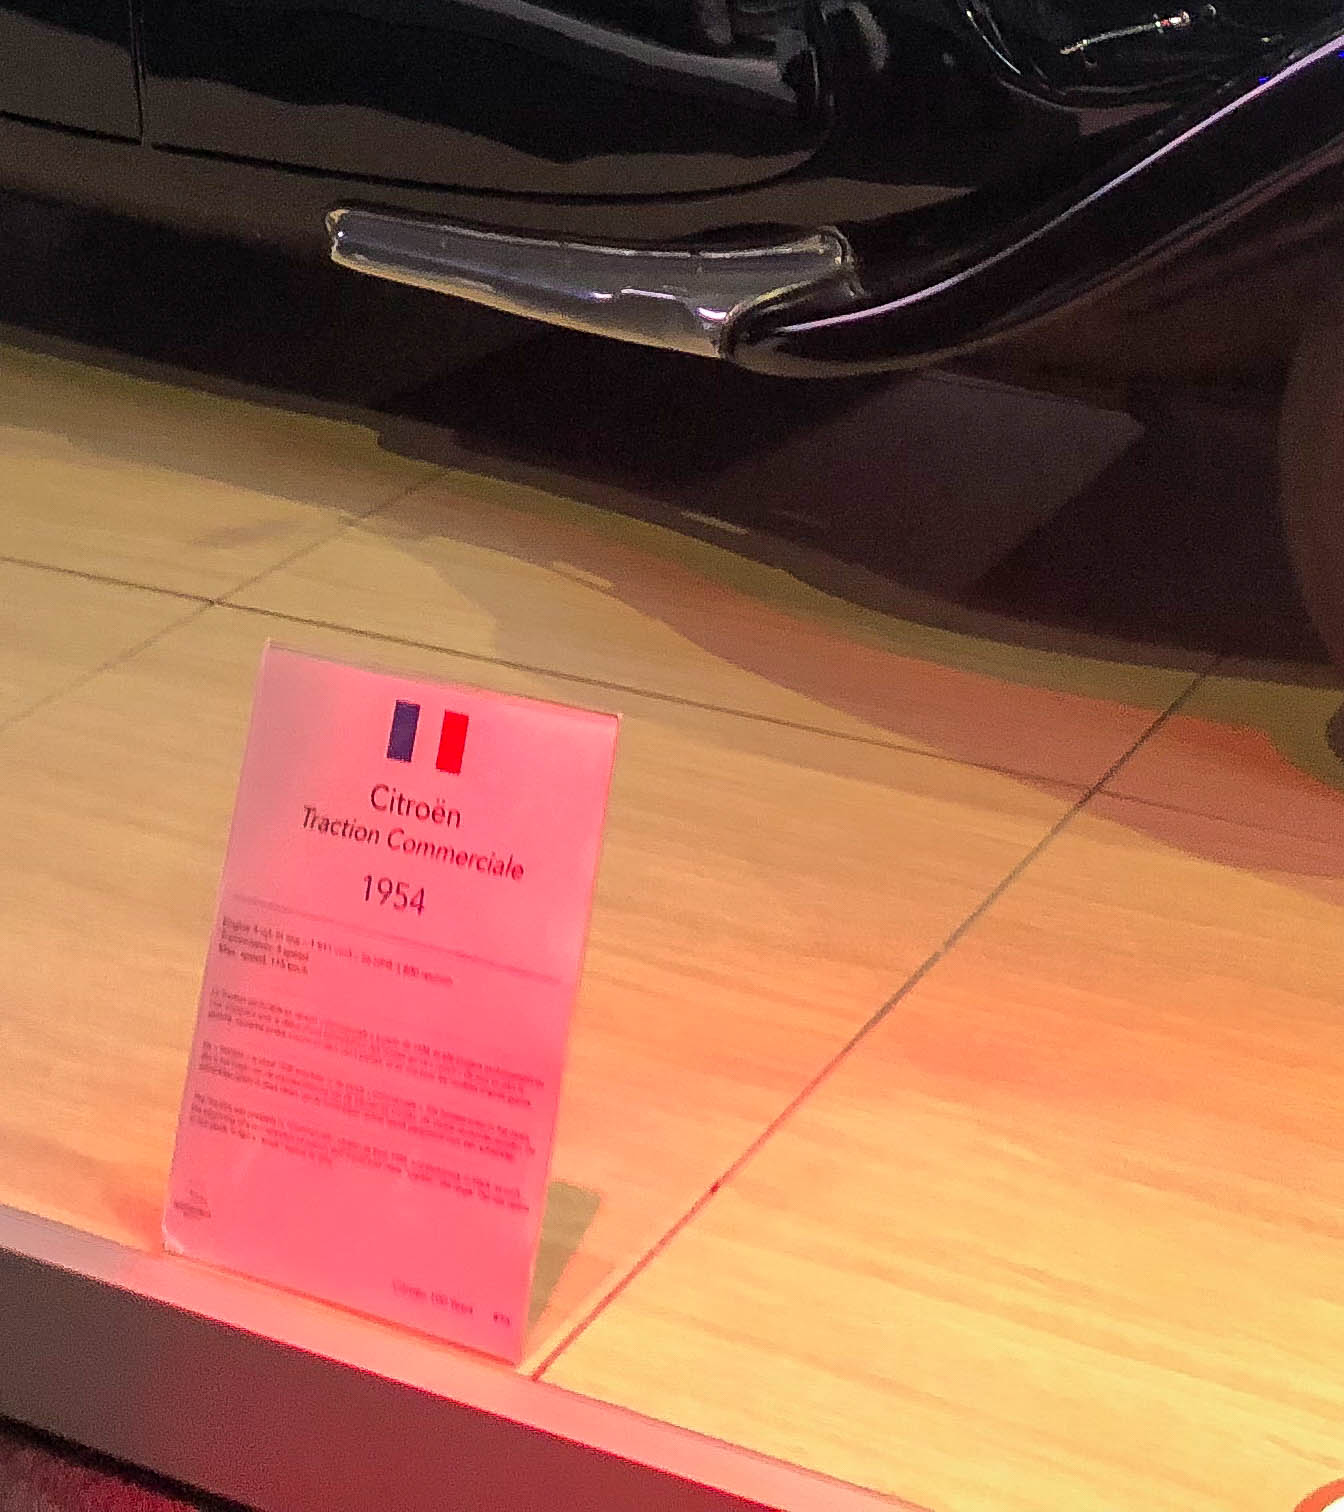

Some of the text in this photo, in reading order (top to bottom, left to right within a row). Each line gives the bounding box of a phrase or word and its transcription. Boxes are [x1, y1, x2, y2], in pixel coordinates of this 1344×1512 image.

[368, 782, 462, 830] Citroën
[301, 805, 525, 882] Traction Commerciale
[361, 874, 427, 916] 1954
